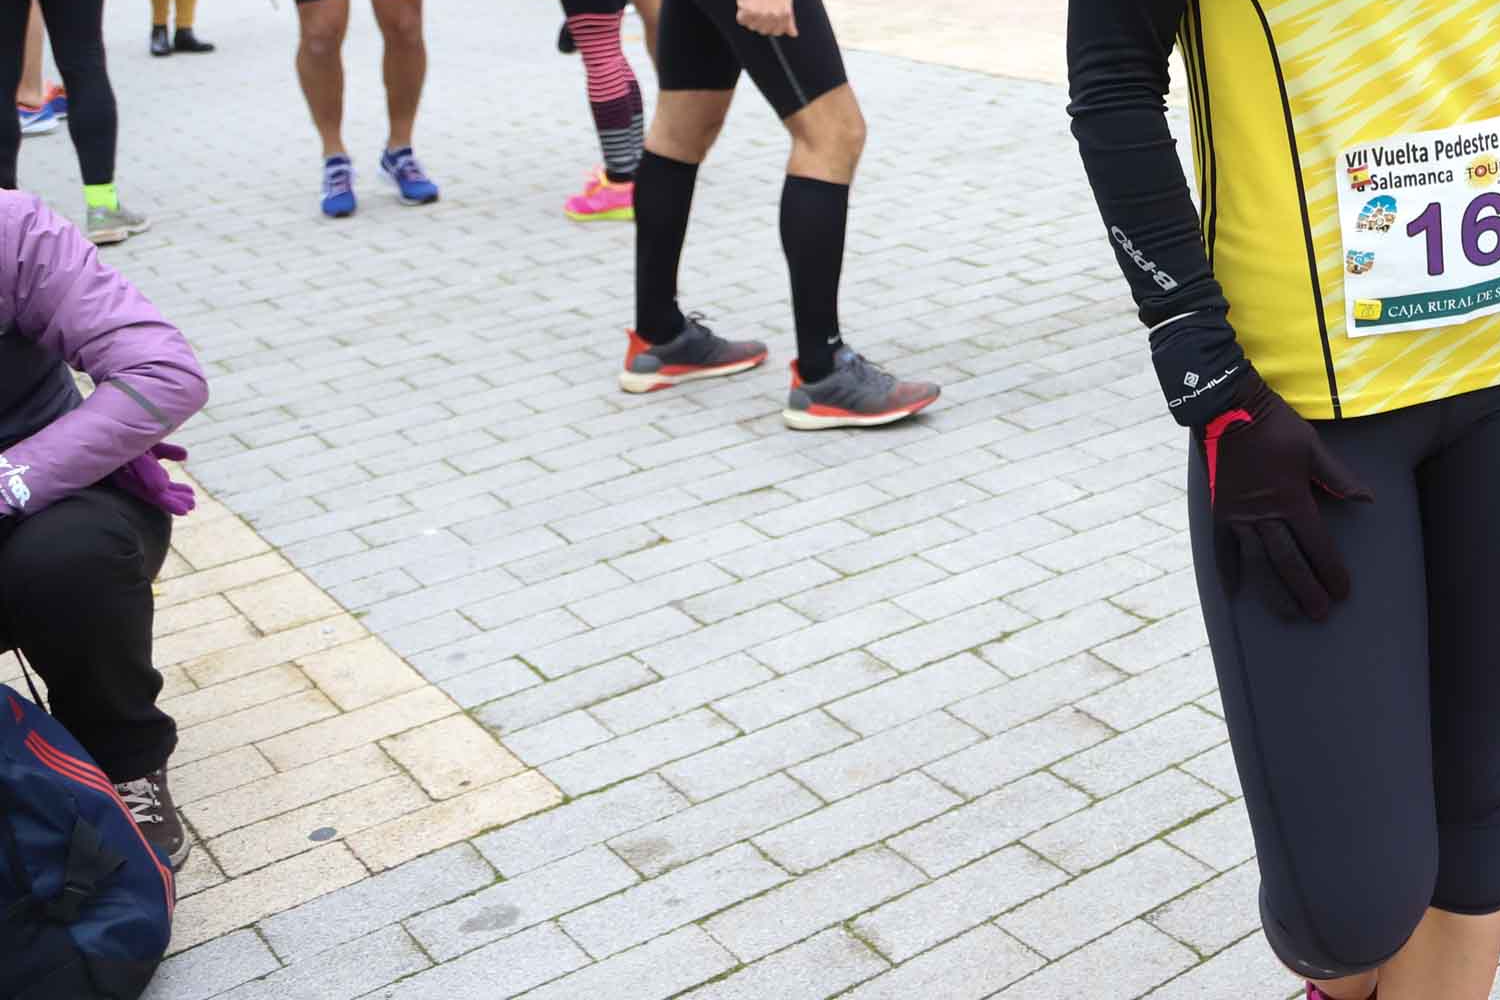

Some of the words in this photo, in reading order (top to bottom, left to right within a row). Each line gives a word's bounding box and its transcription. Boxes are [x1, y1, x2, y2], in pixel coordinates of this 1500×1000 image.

[1371, 142, 1429, 168] Vuelta
[1434, 132, 1499, 161] Pedestre
[1370, 169, 1454, 191] Salamanca
[1111, 225, 1179, 291] B-PRO
[1388, 304, 1424, 318] CAJA
[1428, 295, 1474, 313] RURAL
[1476, 289, 1493, 304] DE
[1169, 365, 1239, 408] ONHILL
